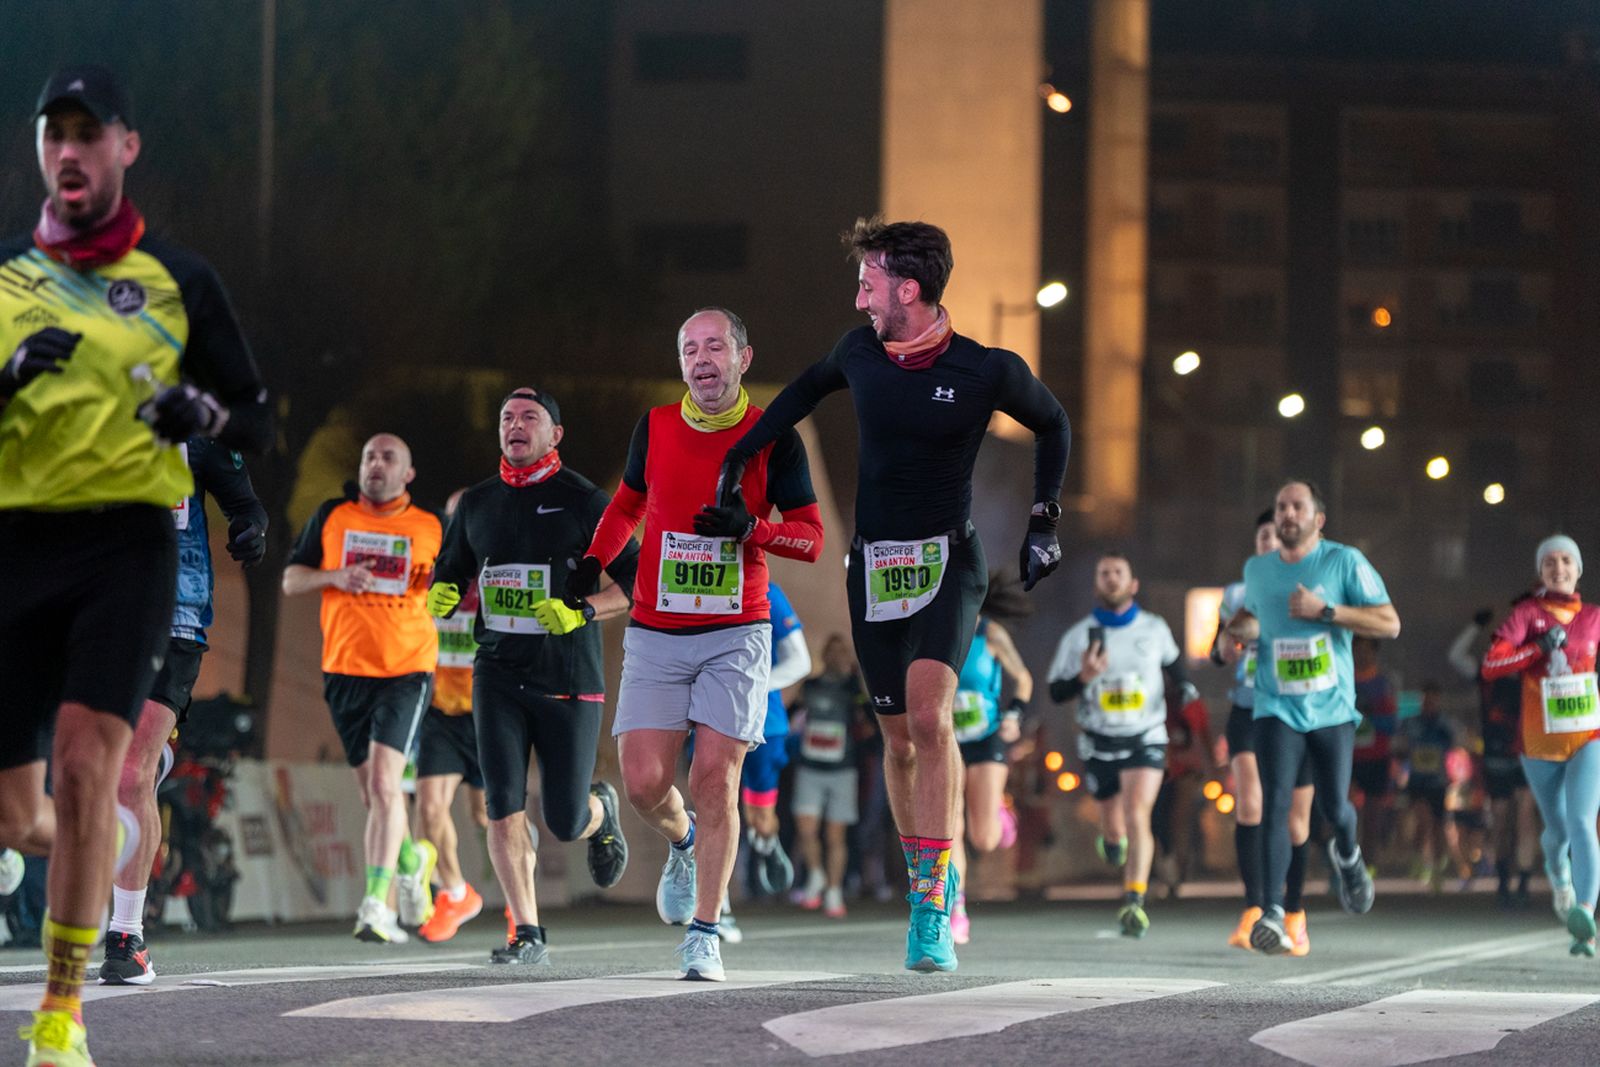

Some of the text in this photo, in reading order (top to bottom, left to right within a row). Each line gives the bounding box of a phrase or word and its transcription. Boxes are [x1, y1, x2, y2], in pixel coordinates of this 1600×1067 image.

[677, 542, 701, 551] NOCHE
[703, 543, 713, 552] DE
[880, 546, 915, 557] NOCHE DE
[668, 550, 683, 560] SAN
[684, 550, 713, 562] ANTÓN
[875, 560, 888, 569] SAN
[889, 557, 915, 567] ANTÓN
[674, 561, 726, 587] 9167
[882, 565, 931, 593] 1990
[495, 588, 535, 611] 4621
[1287, 656, 1322, 677] 3716
